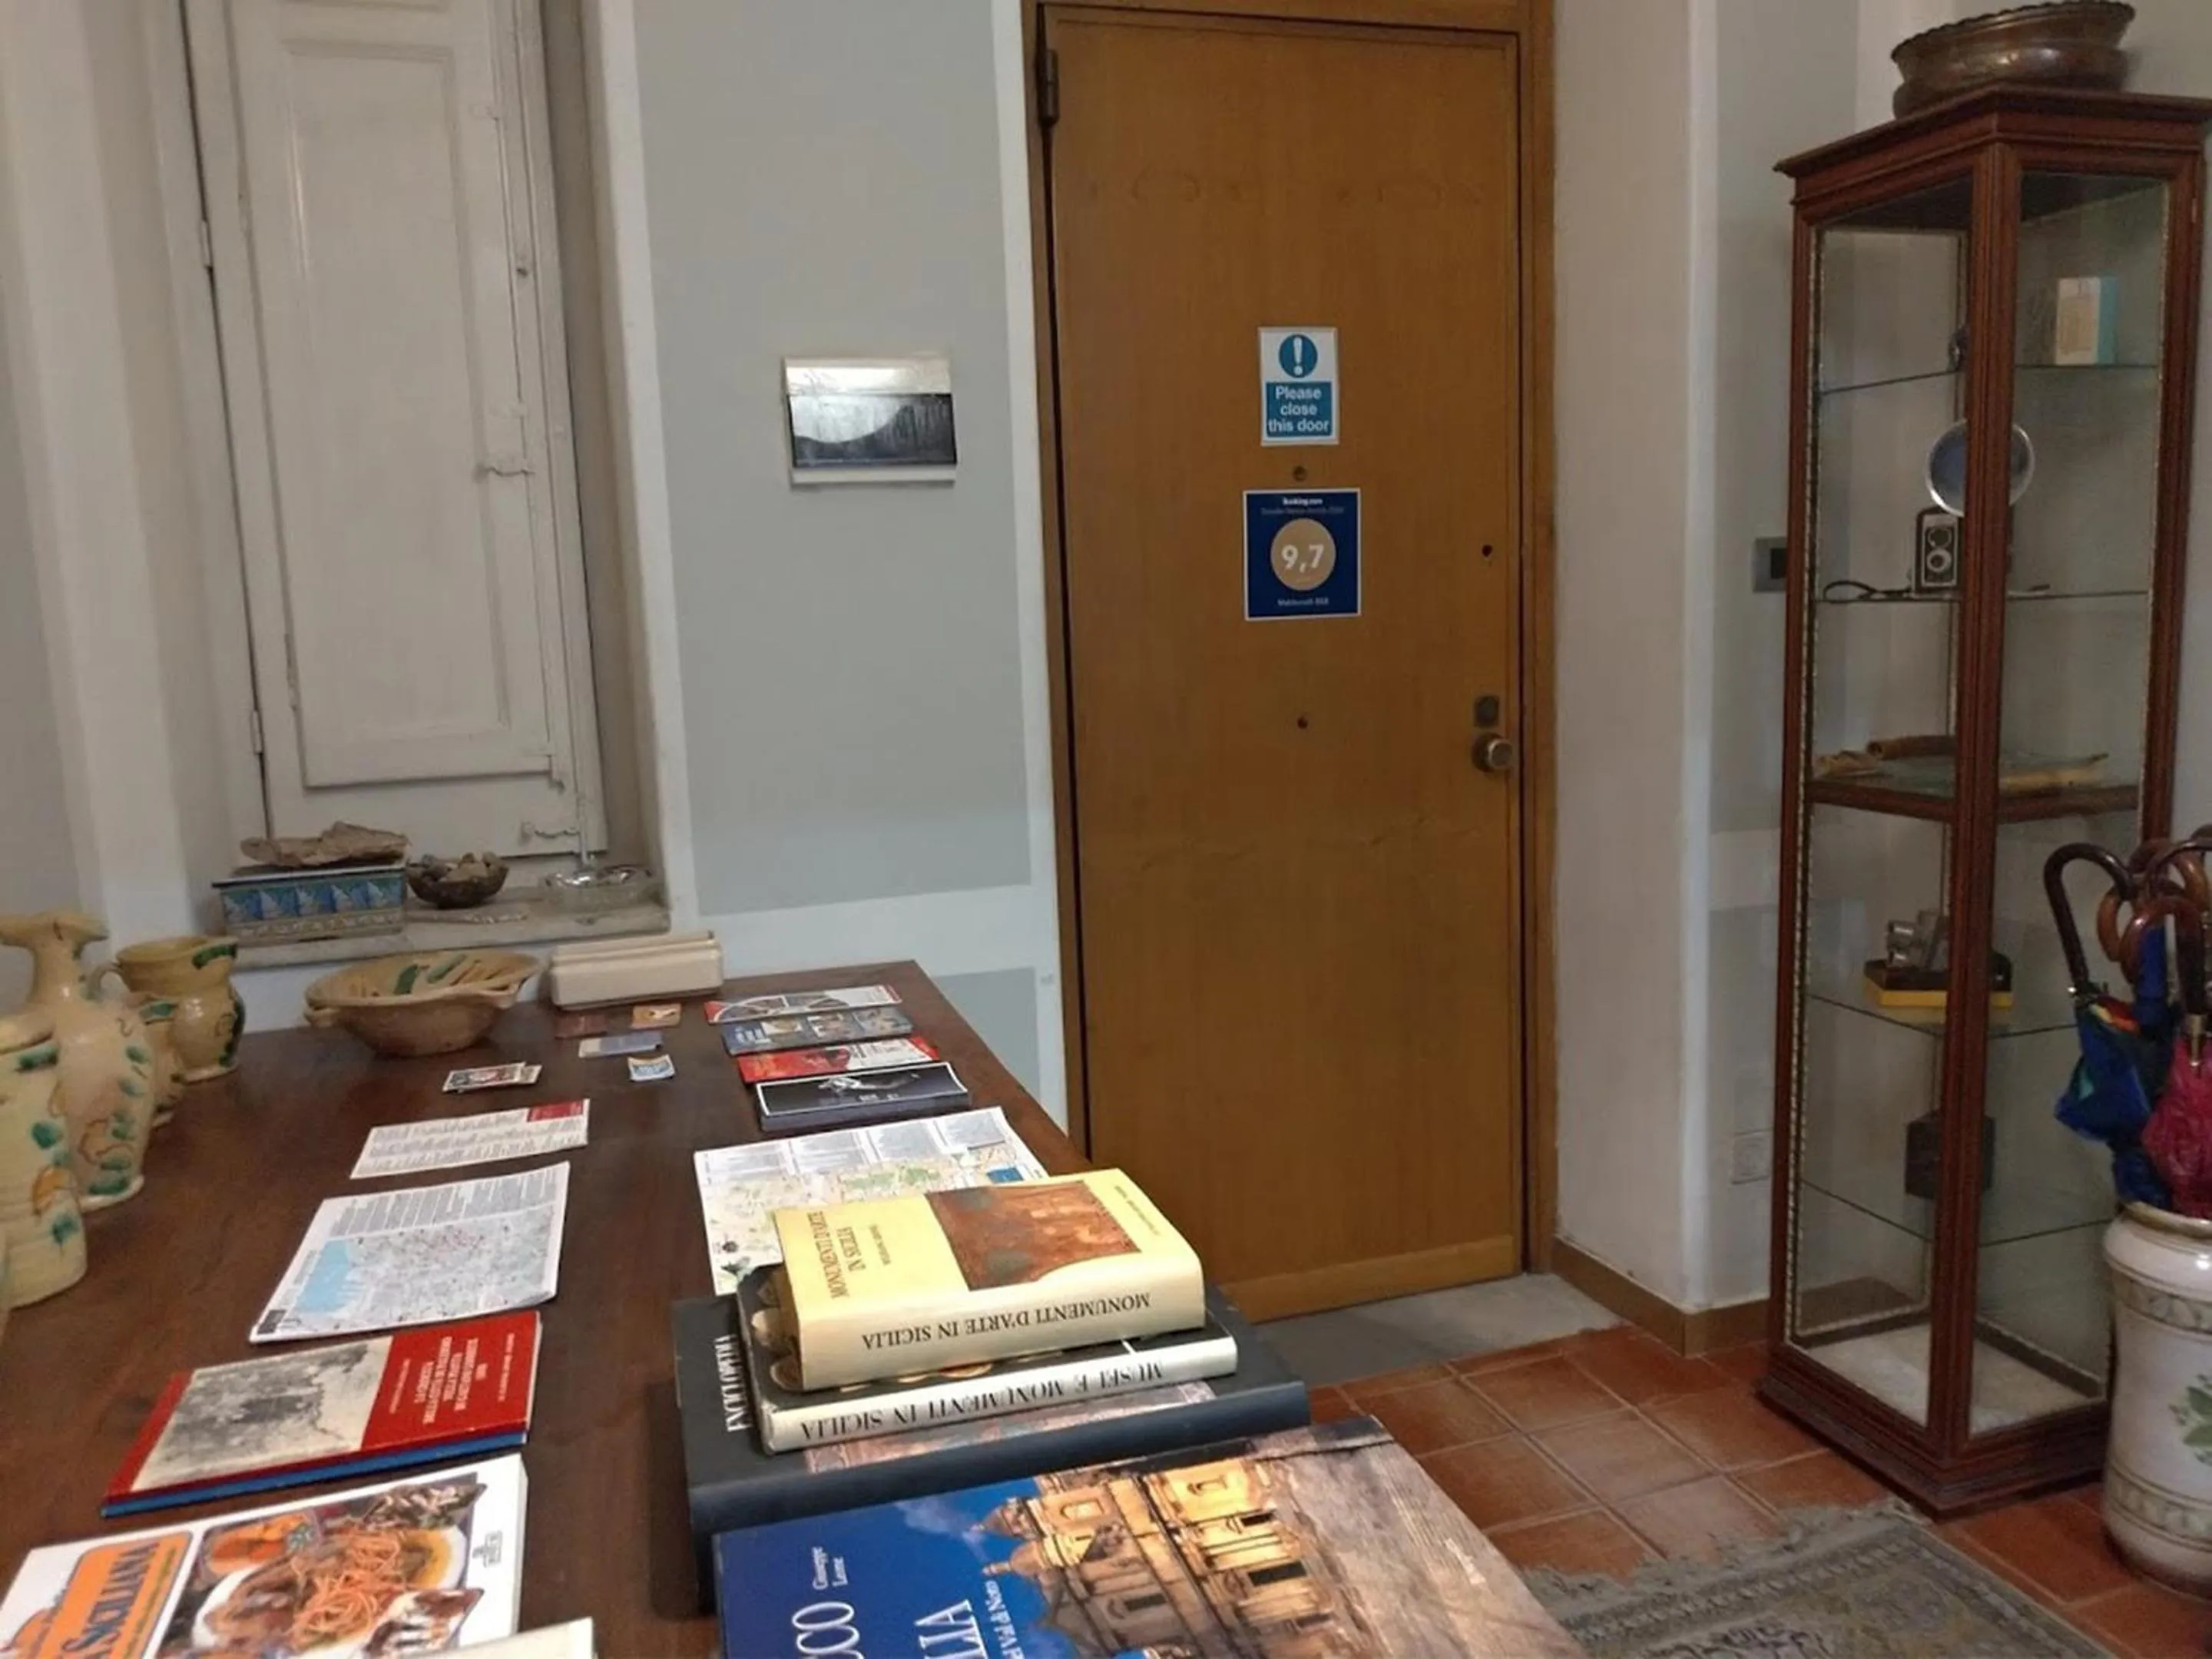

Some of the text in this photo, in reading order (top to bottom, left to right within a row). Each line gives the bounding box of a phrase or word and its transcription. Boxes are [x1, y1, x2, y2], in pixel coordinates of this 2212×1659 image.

[1275, 386, 1322, 399] Please
[1280, 402, 1317, 416] close
[1268, 419, 1330, 432] this door
[1281, 544, 1325, 574] 9,7
[861, 1292, 1152, 1351] MONUMENTI D'ARTE IN SICILIA
[800, 1360, 1165, 1441] MUSEI E MONUMENTI IN SICILIA
